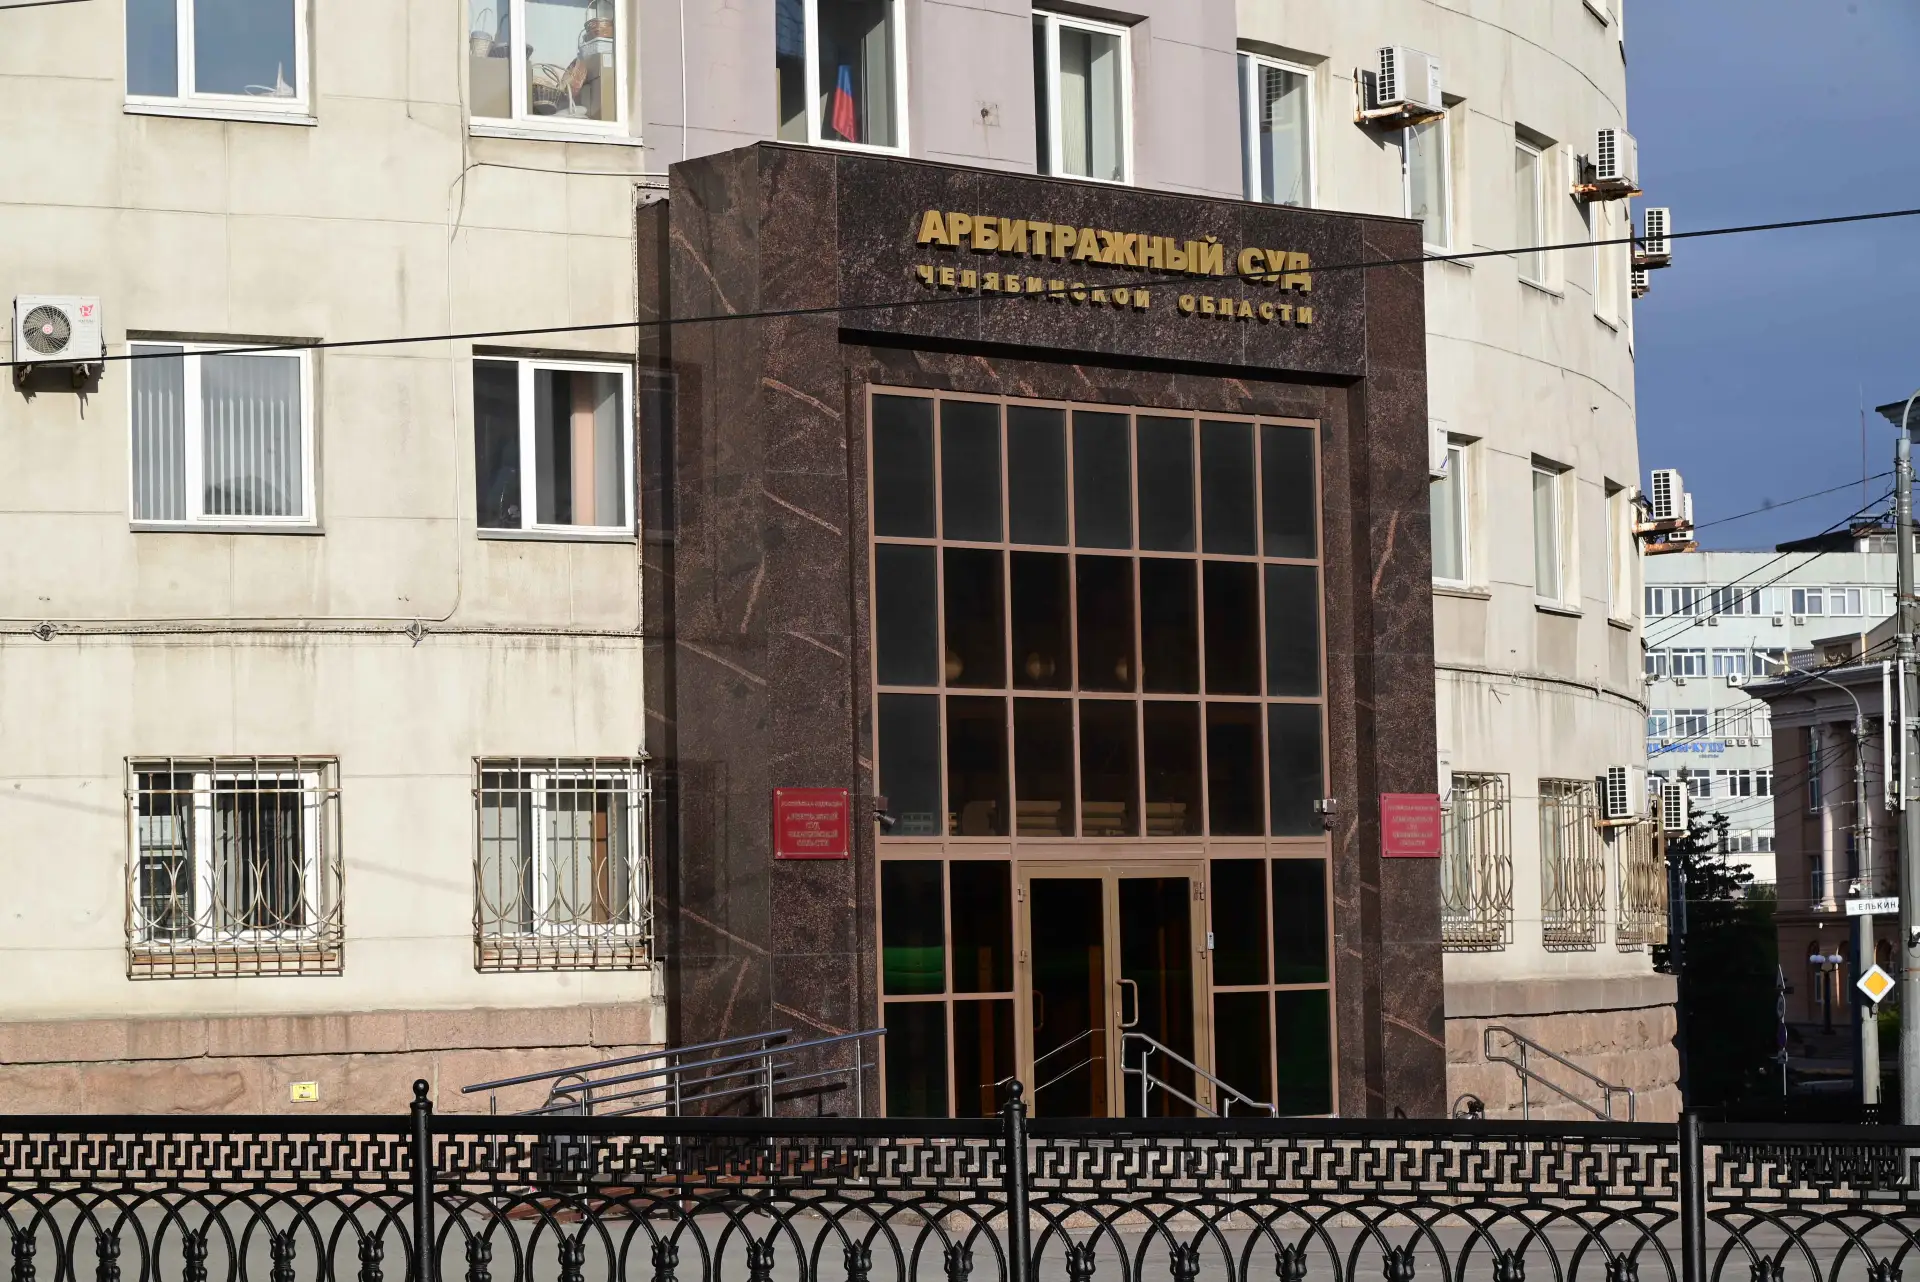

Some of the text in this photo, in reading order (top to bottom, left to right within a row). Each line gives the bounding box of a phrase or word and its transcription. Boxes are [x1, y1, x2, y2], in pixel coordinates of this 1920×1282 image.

[917, 209, 1312, 292] АРБИТРАЖНЫЙ СУД
[917, 264, 1313, 325] ЧЕЛЯБИНСКОЙ ОБЛАСТИ
[1858, 901, 1899, 911] ЕЛЬКИН
